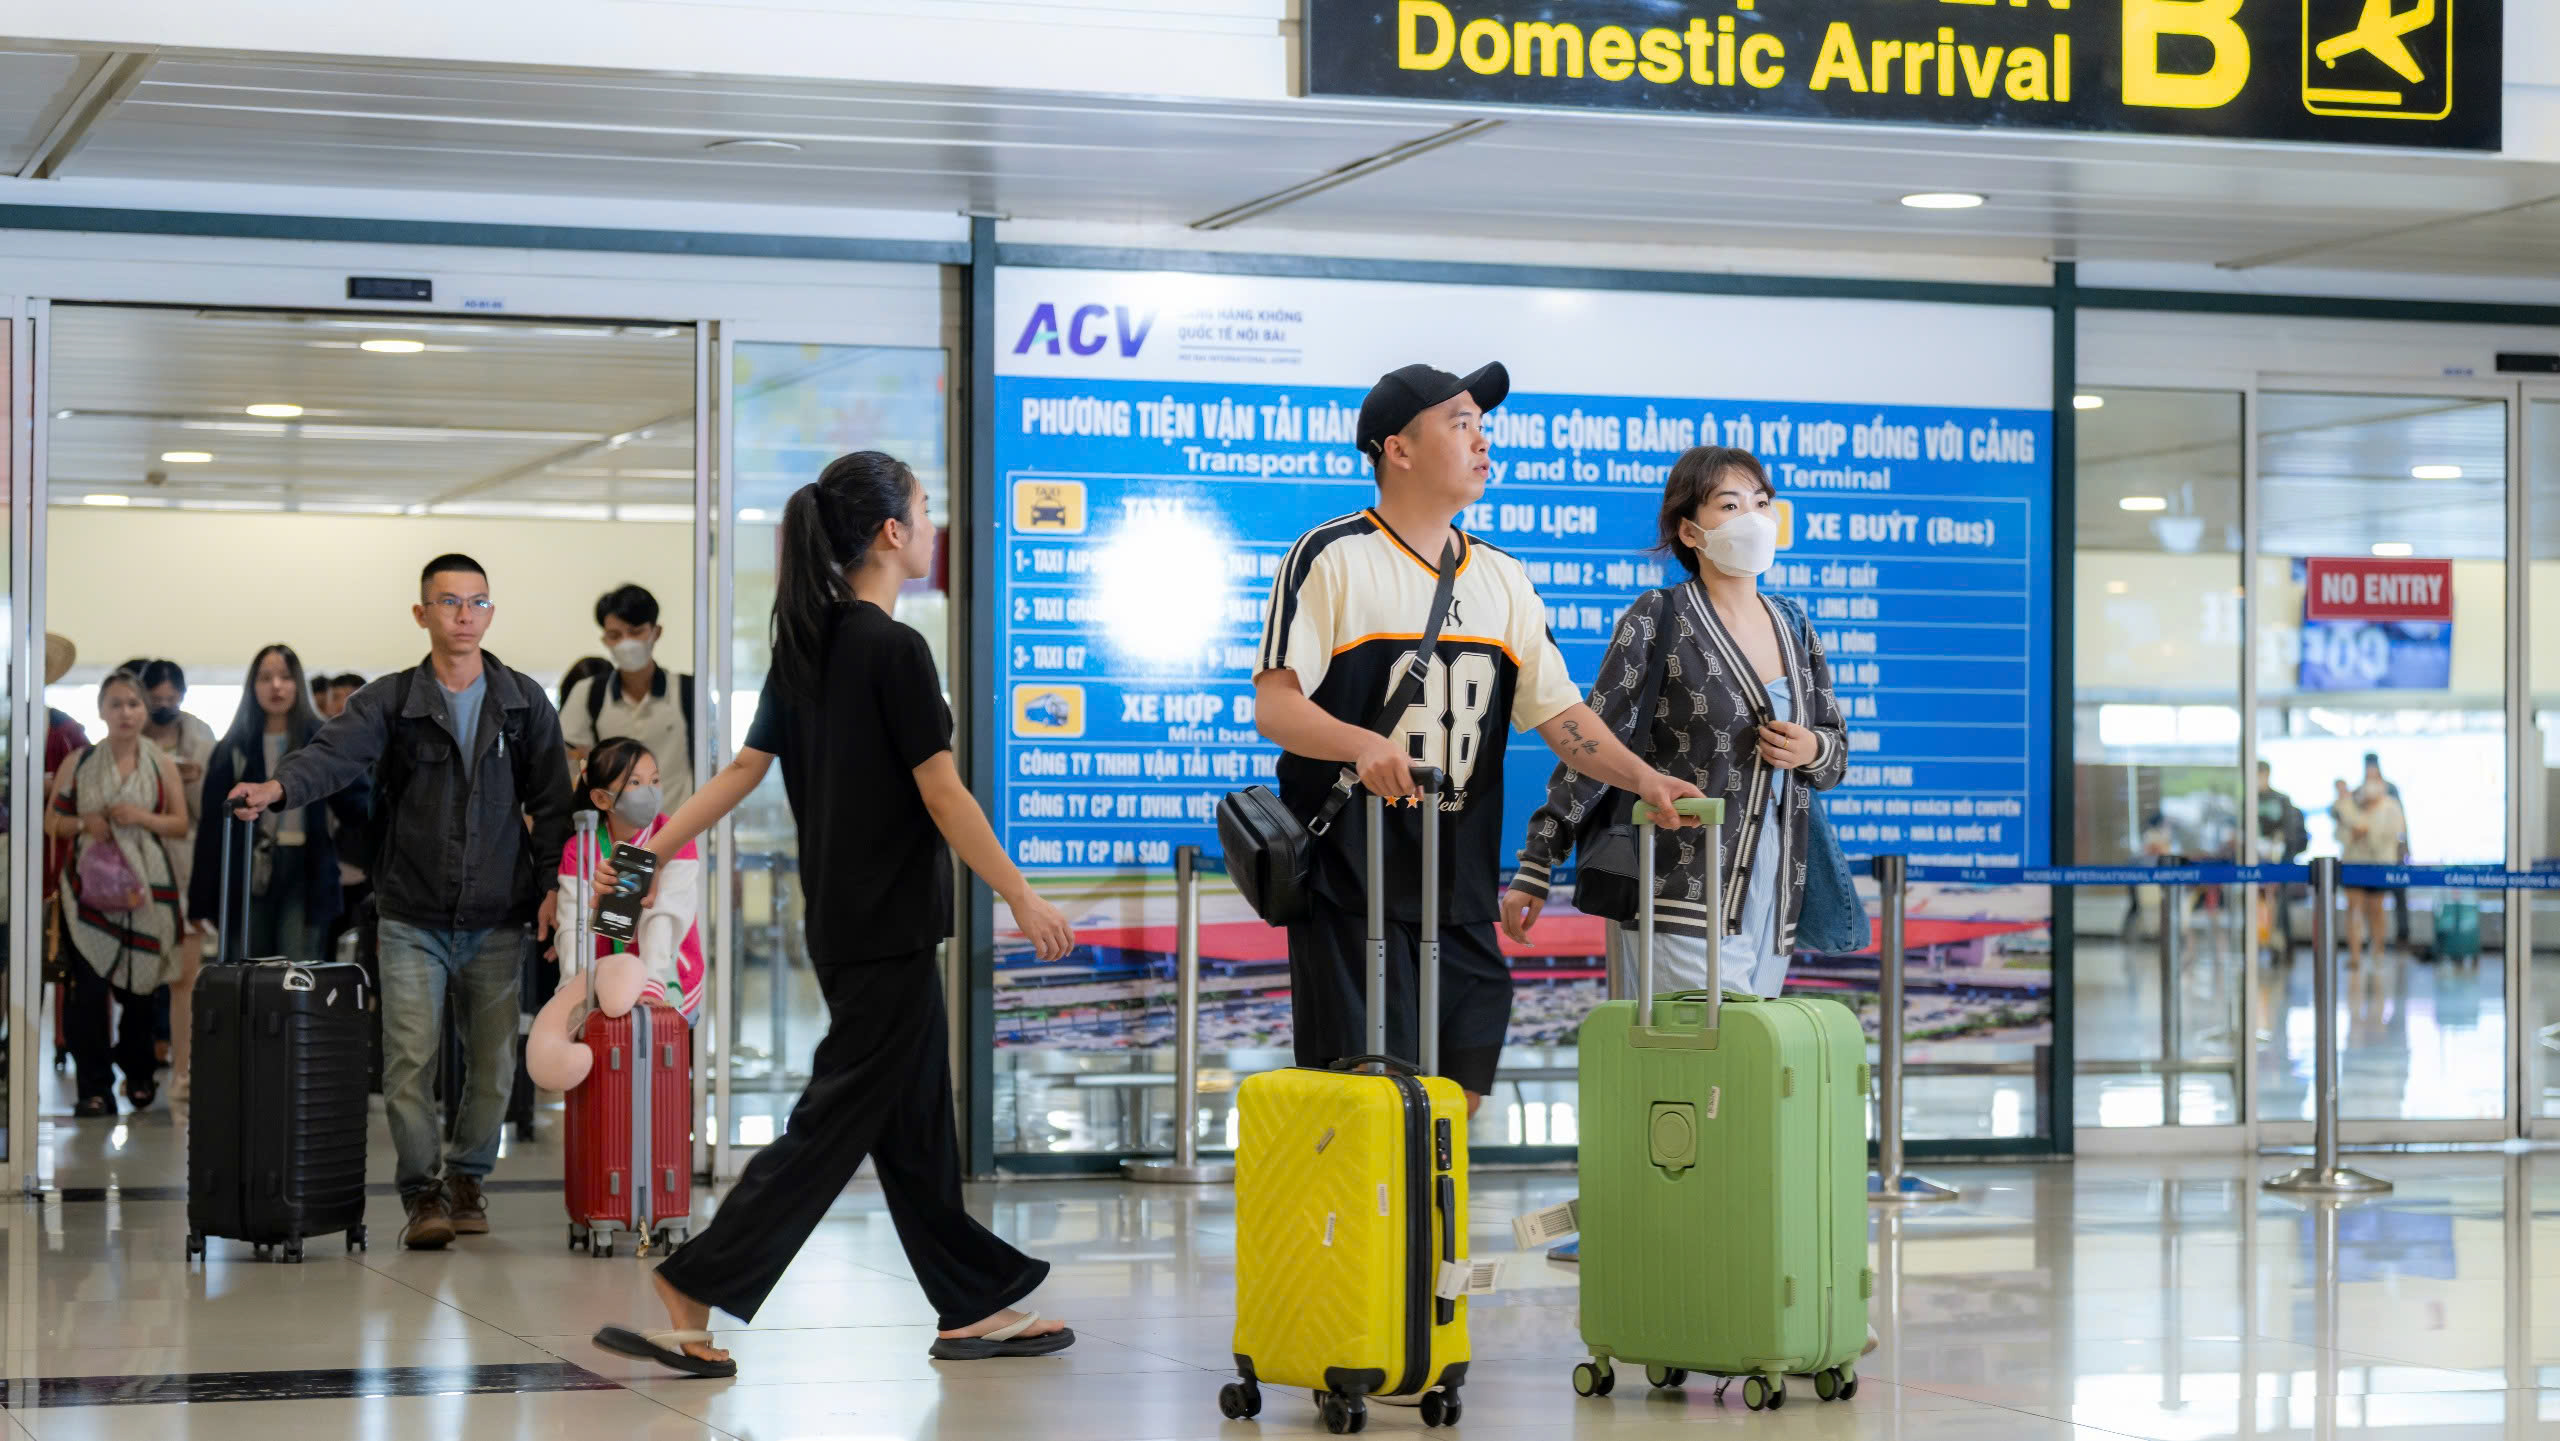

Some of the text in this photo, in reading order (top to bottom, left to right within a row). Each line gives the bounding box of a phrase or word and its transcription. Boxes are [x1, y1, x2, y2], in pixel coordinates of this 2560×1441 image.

[1398, 0, 2070, 102] Domestic Arrival
[1012, 302, 1158, 358] ACV
[1022, 395, 1131, 437] PHƯƠNG
[1136, 394, 1196, 446] TIỆN
[1202, 396, 1256, 447] VẬN
[1260, 394, 1301, 441] TẢI
[1308, 399, 1360, 443] HÀN
[1552, 407, 1620, 457] CỘNG
[1760, 414, 1792, 456] KÝ
[1797, 419, 1848, 465] HỢP
[1969, 416, 2036, 464] CẢNG
[1182, 446, 1319, 478] Transport
[1325, 451, 1355, 476] to
[1515, 457, 1566, 481] and
[1572, 458, 1600, 482] to
[1778, 463, 1891, 491] Terminal
[1034, 487, 1061, 498] TAXI
[1460, 503, 1598, 540] XE DU LỊCH
[1806, 510, 1996, 547] XE BUÝT (Bus)
[1032, 549, 1064, 574] TAXI
[1582, 562, 1595, 586] 2
[2321, 573, 2444, 606] NO ENTRY
[1032, 597, 1064, 622] TAXI
[1014, 645, 1087, 670] 3- TAXI G7
[1122, 694, 1160, 722] XE
[1163, 692, 1224, 731] HỢP
[1167, 726, 1259, 744] Mini bus
[1018, 747, 1068, 776] CÔNG
[1070, 752, 1092, 776] TY
[1094, 753, 1140, 777] TNHH
[1143, 748, 1179, 782] VẬN
[1181, 747, 1209, 777] TẢI
[1211, 750, 1248, 782] VIỆT
[1018, 789, 1064, 818] CÔNG
[1067, 795, 1087, 818] TY
[1090, 795, 1114, 818] CP
[1185, 792, 1221, 824] VIỆT
[1017, 835, 1170, 864] CÔNG TY CP BA SAO
